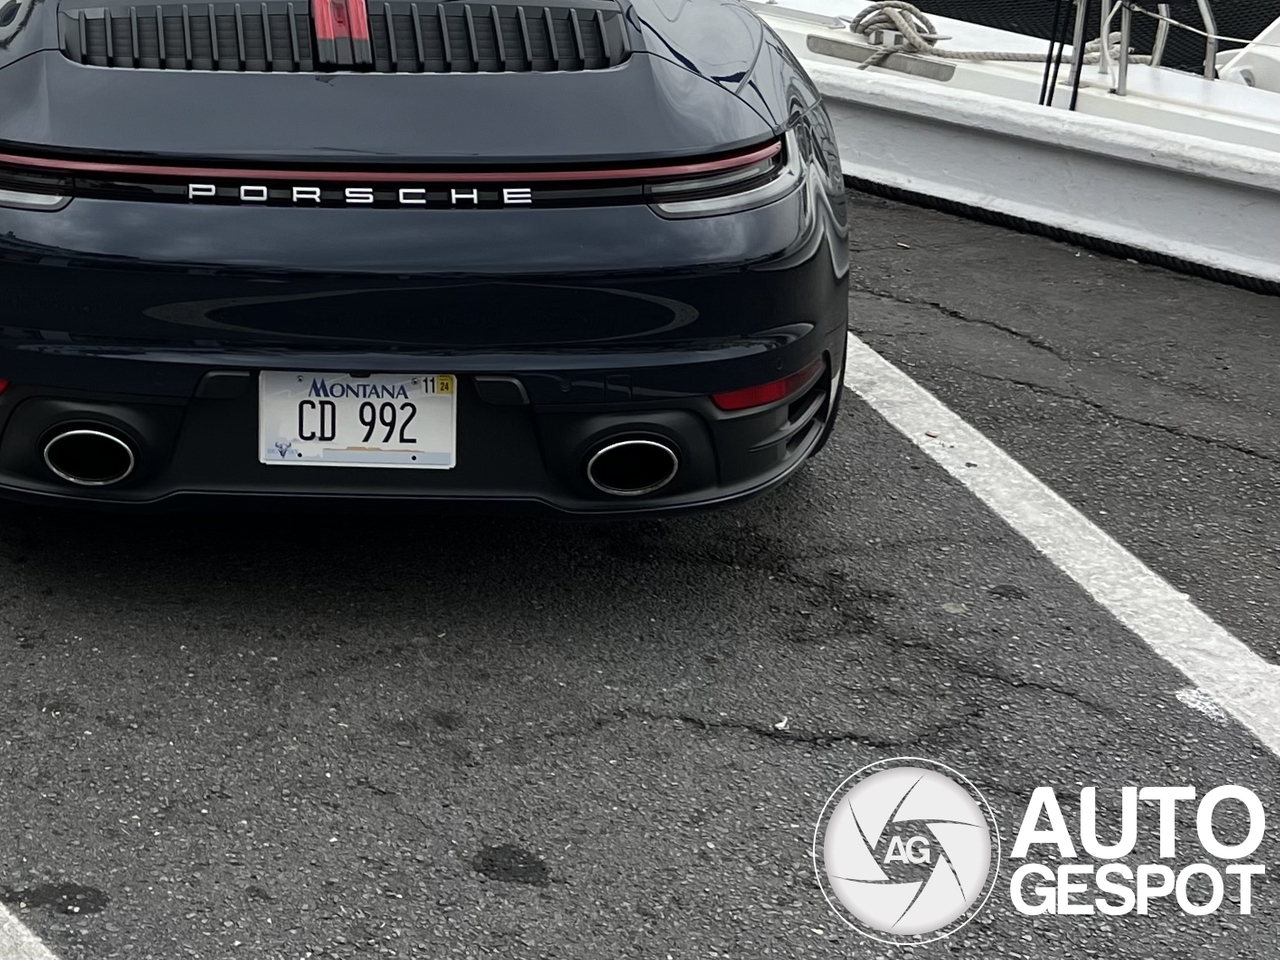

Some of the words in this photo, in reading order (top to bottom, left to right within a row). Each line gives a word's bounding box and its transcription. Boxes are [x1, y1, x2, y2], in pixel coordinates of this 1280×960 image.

[188, 183, 532, 204] PORSCHE
[308, 377, 409, 400] MONTANA
[423, 376, 436, 394] 11
[440, 381, 450, 392] 24
[298, 399, 336, 441] CD
[358, 401, 417, 444] 992
